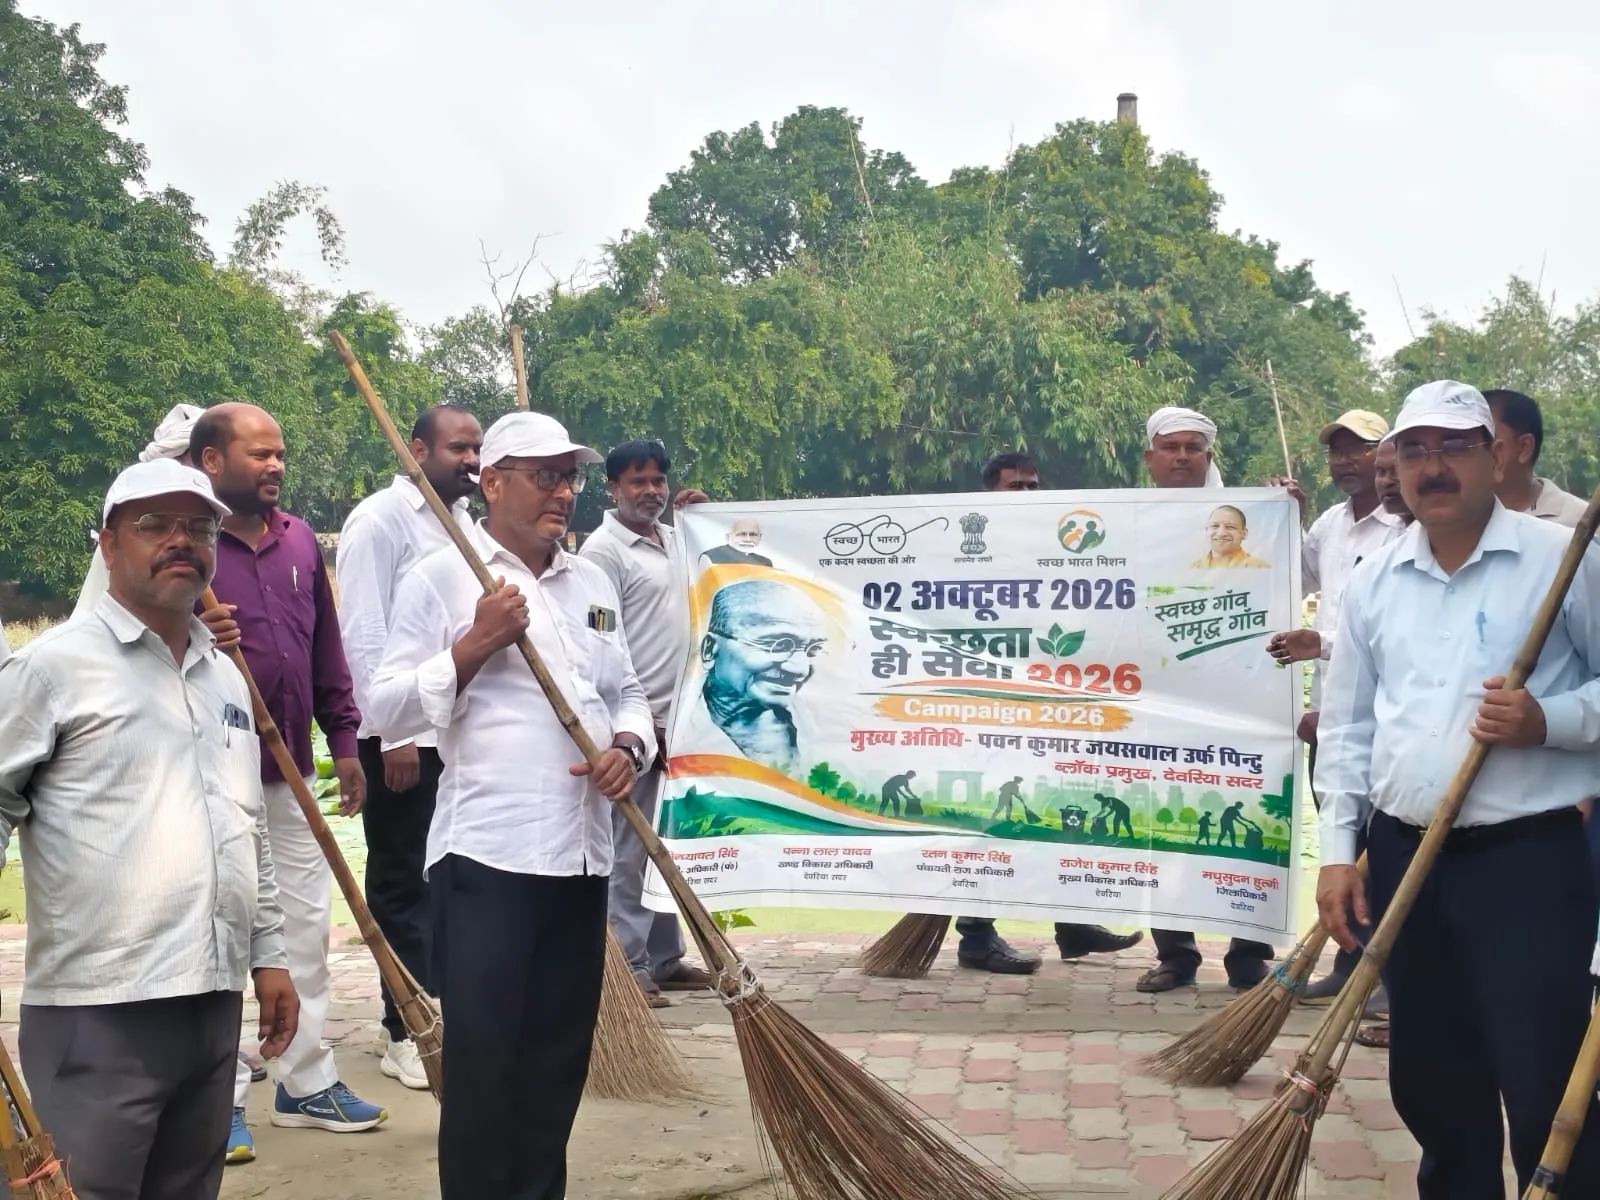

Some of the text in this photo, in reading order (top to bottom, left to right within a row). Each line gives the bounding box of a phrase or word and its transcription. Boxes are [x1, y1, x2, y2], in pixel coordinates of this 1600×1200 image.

[833, 535, 900, 545] स्वच्छ भारत
[819, 554, 916, 567] एक कदम स्वच्छता की ओर
[1037, 555, 1126, 567] स्वच्छ भारत मिशन
[863, 579, 1136, 621] 02 अक्टूबर 2026
[1155, 598, 1208, 622] स्वच्छ
[1167, 617, 1223, 645] समृद्ध
[871, 644, 912, 679] ही
[1026, 663, 1142, 695] 2026
[904, 699, 1105, 726] Campaign 2026
[850, 729, 897, 752] मुख्य
[978, 733, 1023, 750] पवन
[1027, 735, 1081, 757] कुमार
[1085, 739, 1177, 763] जयसवाल
[1183, 745, 1215, 765] उर्फ
[1106, 765, 1156, 783] प्रमुख,
[1163, 768, 1221, 786] देवरिया
[1225, 776, 1264, 790] सदर
[669, 847, 740, 860] न्ध्याचल सिंह
[783, 847, 872, 856] पन्ना लाल यादव
[921, 850, 1012, 864] रतन कुमार सिंह
[686, 863, 718, 873] अधिकारी
[802, 860, 832, 868] विकास
[834, 860, 873, 869] अधिकारी
[974, 866, 1014, 877] अधिकारी
[1060, 858, 1159, 875] राजेश कुमार सिंह
[1058, 874, 1159, 888] मुख्य विकास अधिकारी
